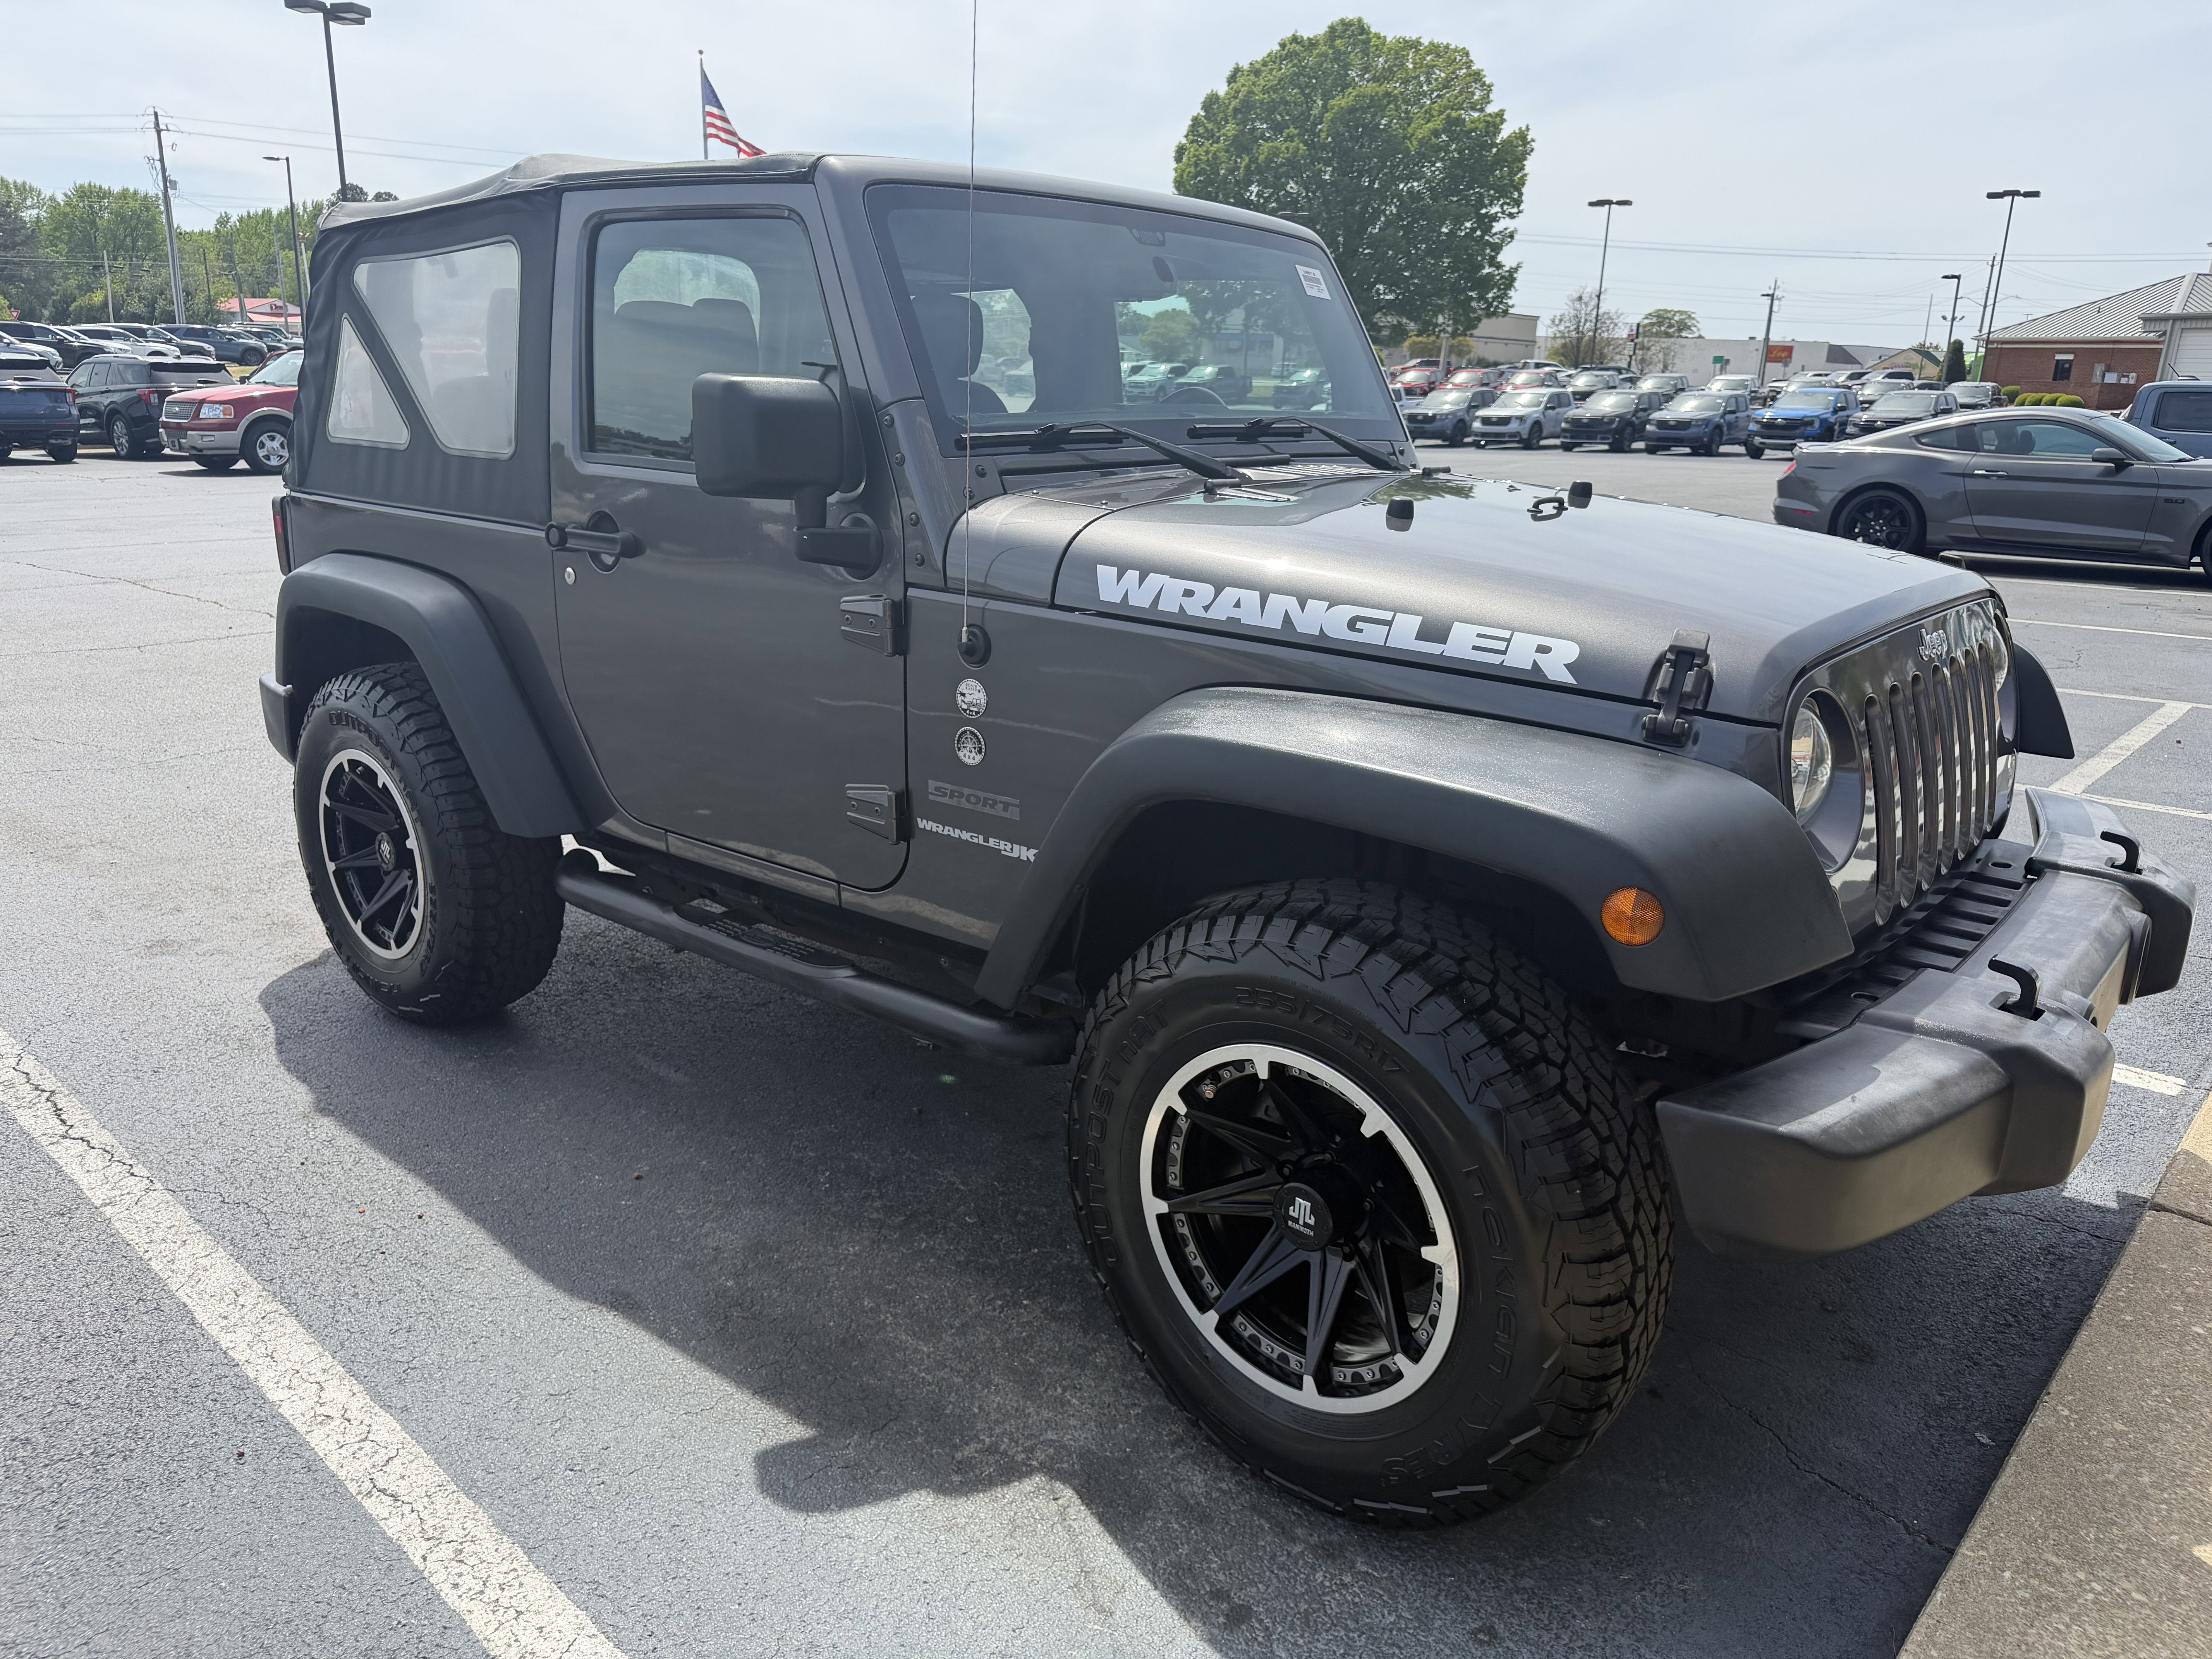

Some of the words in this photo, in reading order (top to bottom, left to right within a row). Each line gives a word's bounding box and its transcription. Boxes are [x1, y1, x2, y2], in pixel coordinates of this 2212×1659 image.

[1096, 564, 1580, 685] WRANGLER
[1917, 629, 1948, 661] Jeep
[929, 786, 1019, 814] SPORT
[917, 817, 1012, 852] WRANGLER
[1235, 986, 1410, 1075] 255/75R17
[1085, 1058, 1122, 1267] OUTPOST
[1288, 1220, 1314, 1237] MAMMOTH
